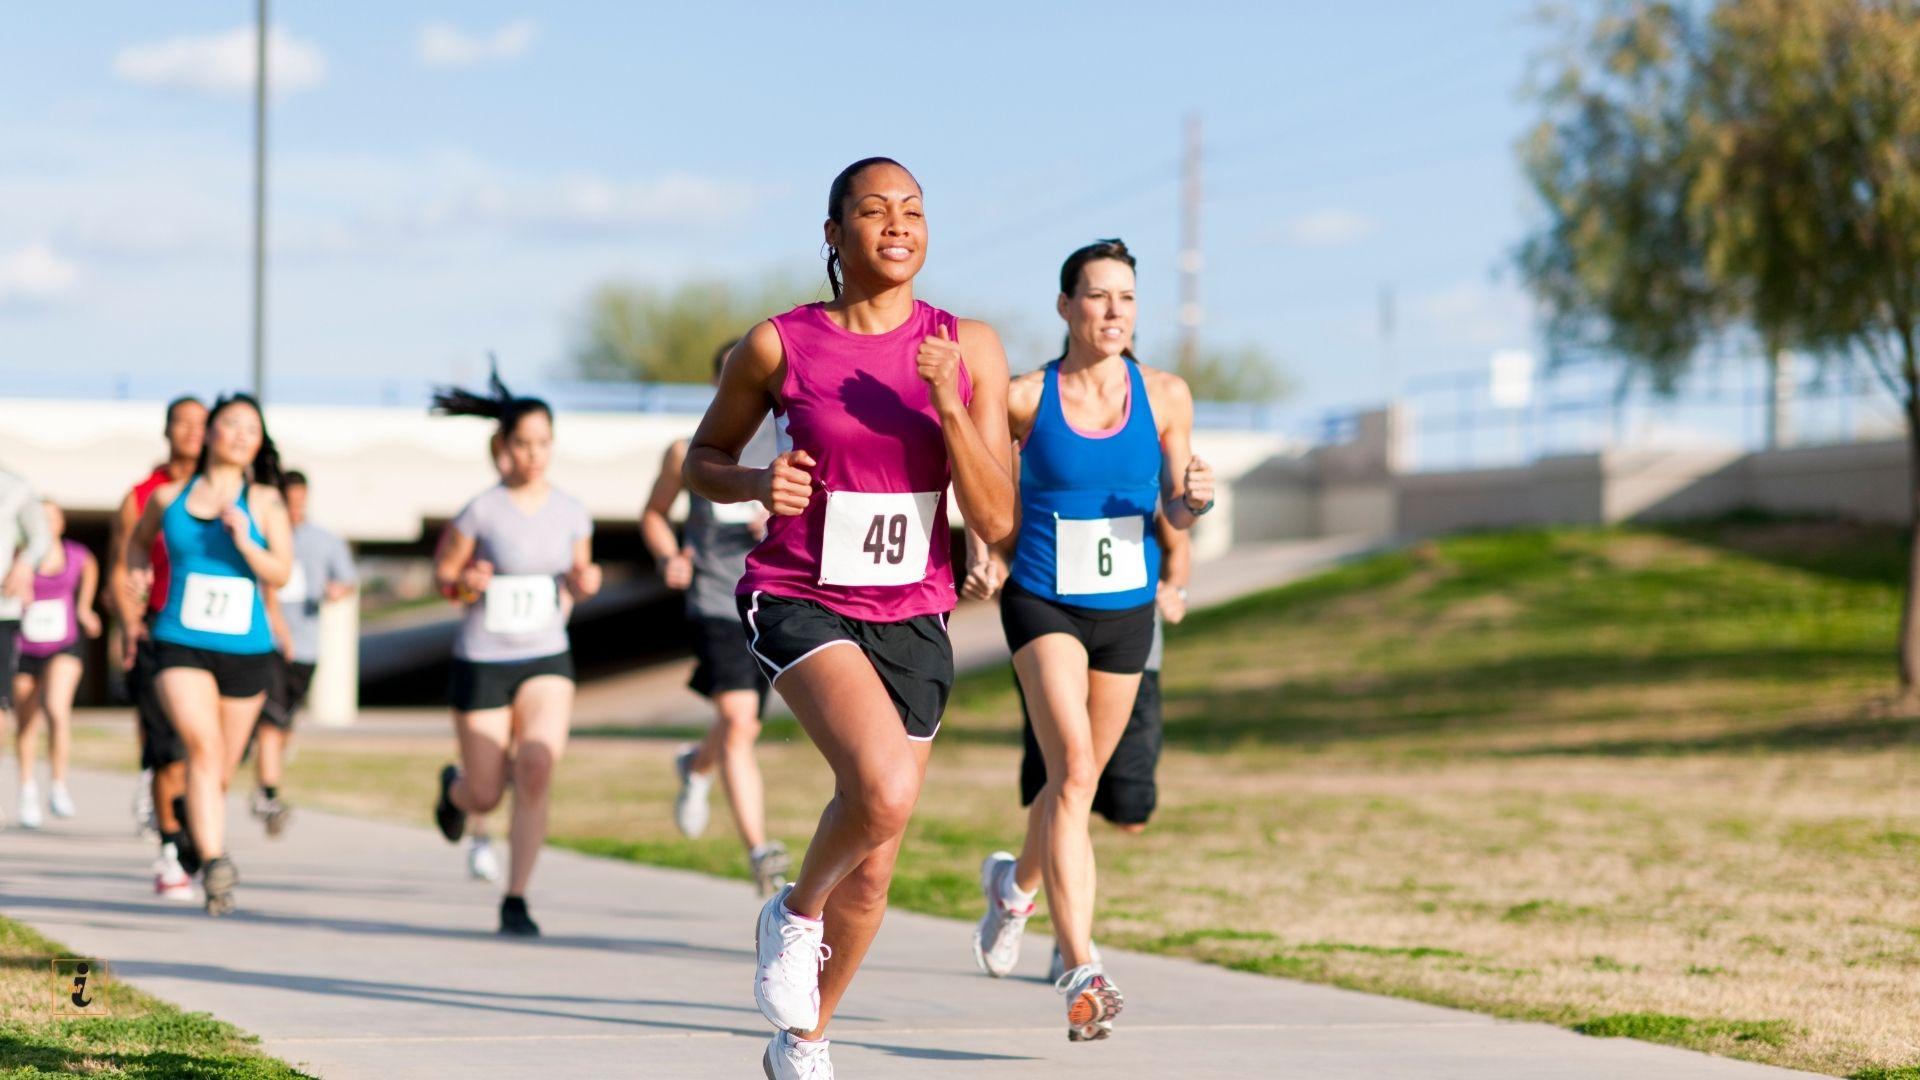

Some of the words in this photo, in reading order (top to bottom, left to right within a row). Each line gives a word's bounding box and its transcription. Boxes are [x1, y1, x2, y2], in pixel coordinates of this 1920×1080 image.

[863, 513, 907, 565] 49
[1098, 537, 1112, 576] 6
[203, 590, 230, 616] 27
